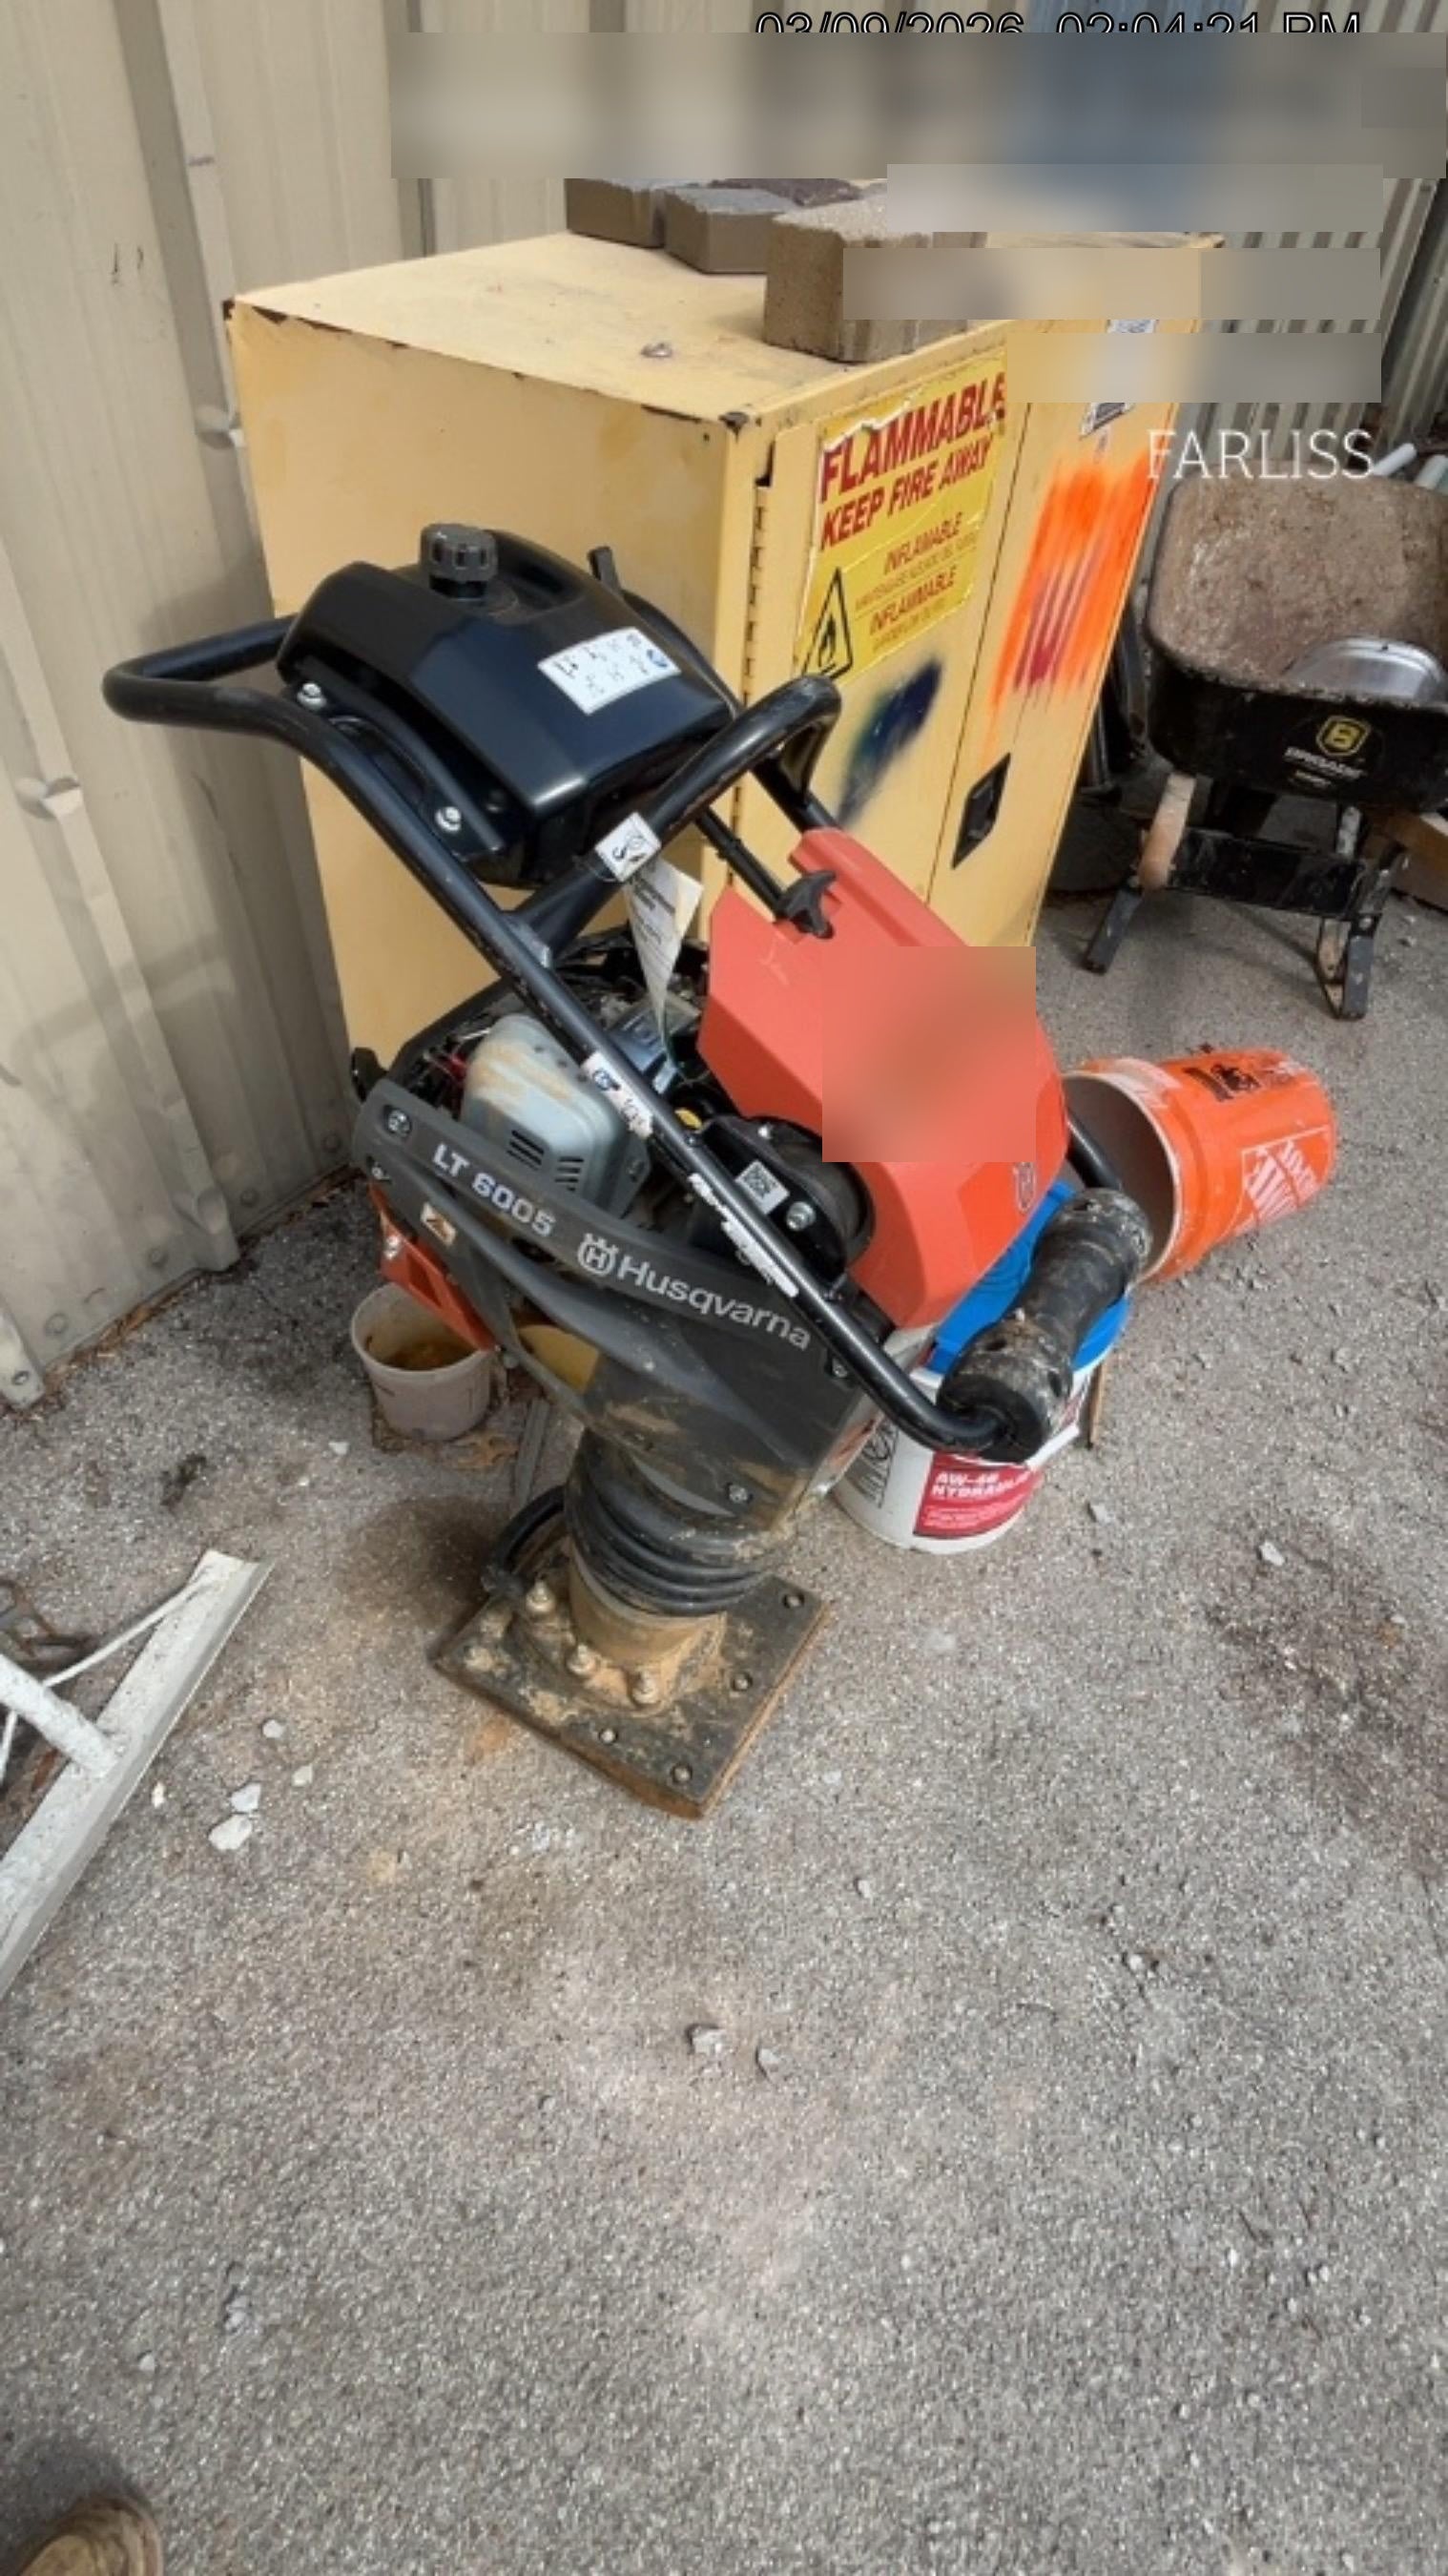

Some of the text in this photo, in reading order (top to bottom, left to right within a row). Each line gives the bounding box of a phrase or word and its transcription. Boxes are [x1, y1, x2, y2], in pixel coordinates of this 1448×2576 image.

[820, 372, 1006, 503] FLAMMABLE
[820, 440, 992, 551] KEEP FIRE AWAY
[432, 1143, 556, 1237] LT 6005
[617, 1255, 811, 1352] Husqvarna
